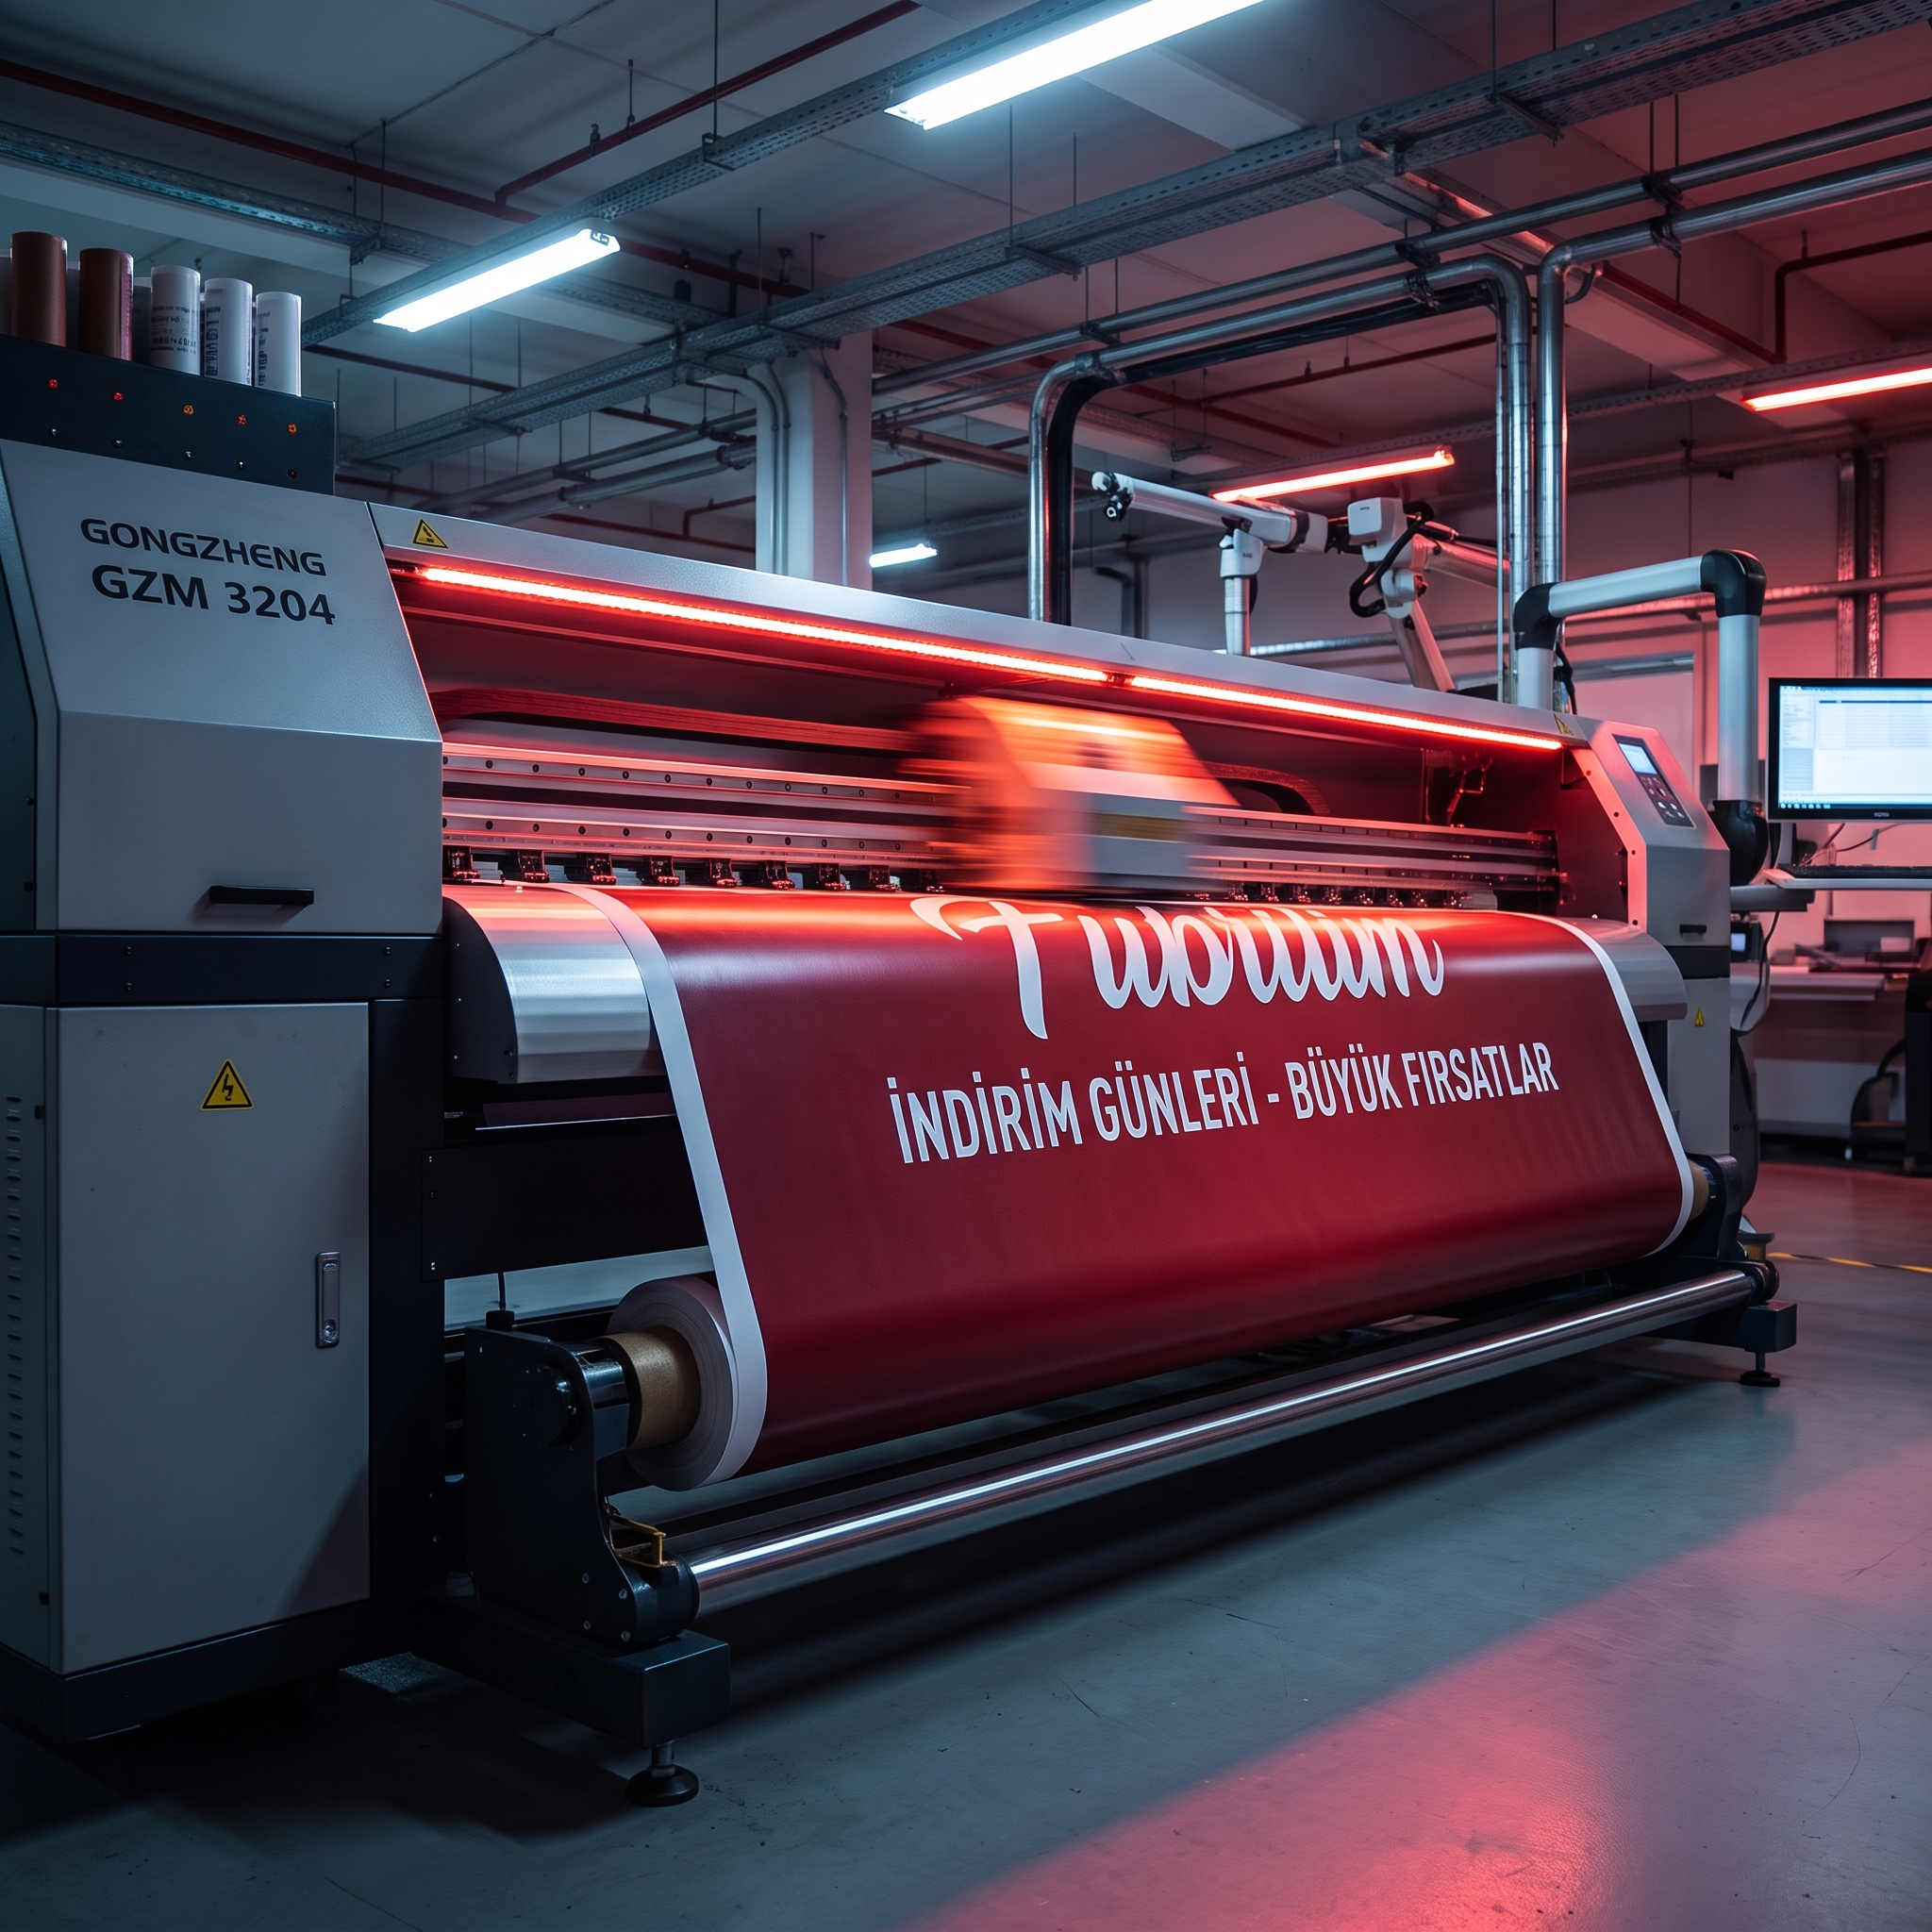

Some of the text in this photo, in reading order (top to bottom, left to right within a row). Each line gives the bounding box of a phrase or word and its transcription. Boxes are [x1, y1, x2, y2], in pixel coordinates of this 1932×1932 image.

[80, 518, 327, 576] GONGZHENG
[92, 565, 336, 625] GZM 3204
[887, 1041, 1560, 1164] İNDİRİM GÜNLERİ - BÜYÜK FIRSATLAR
